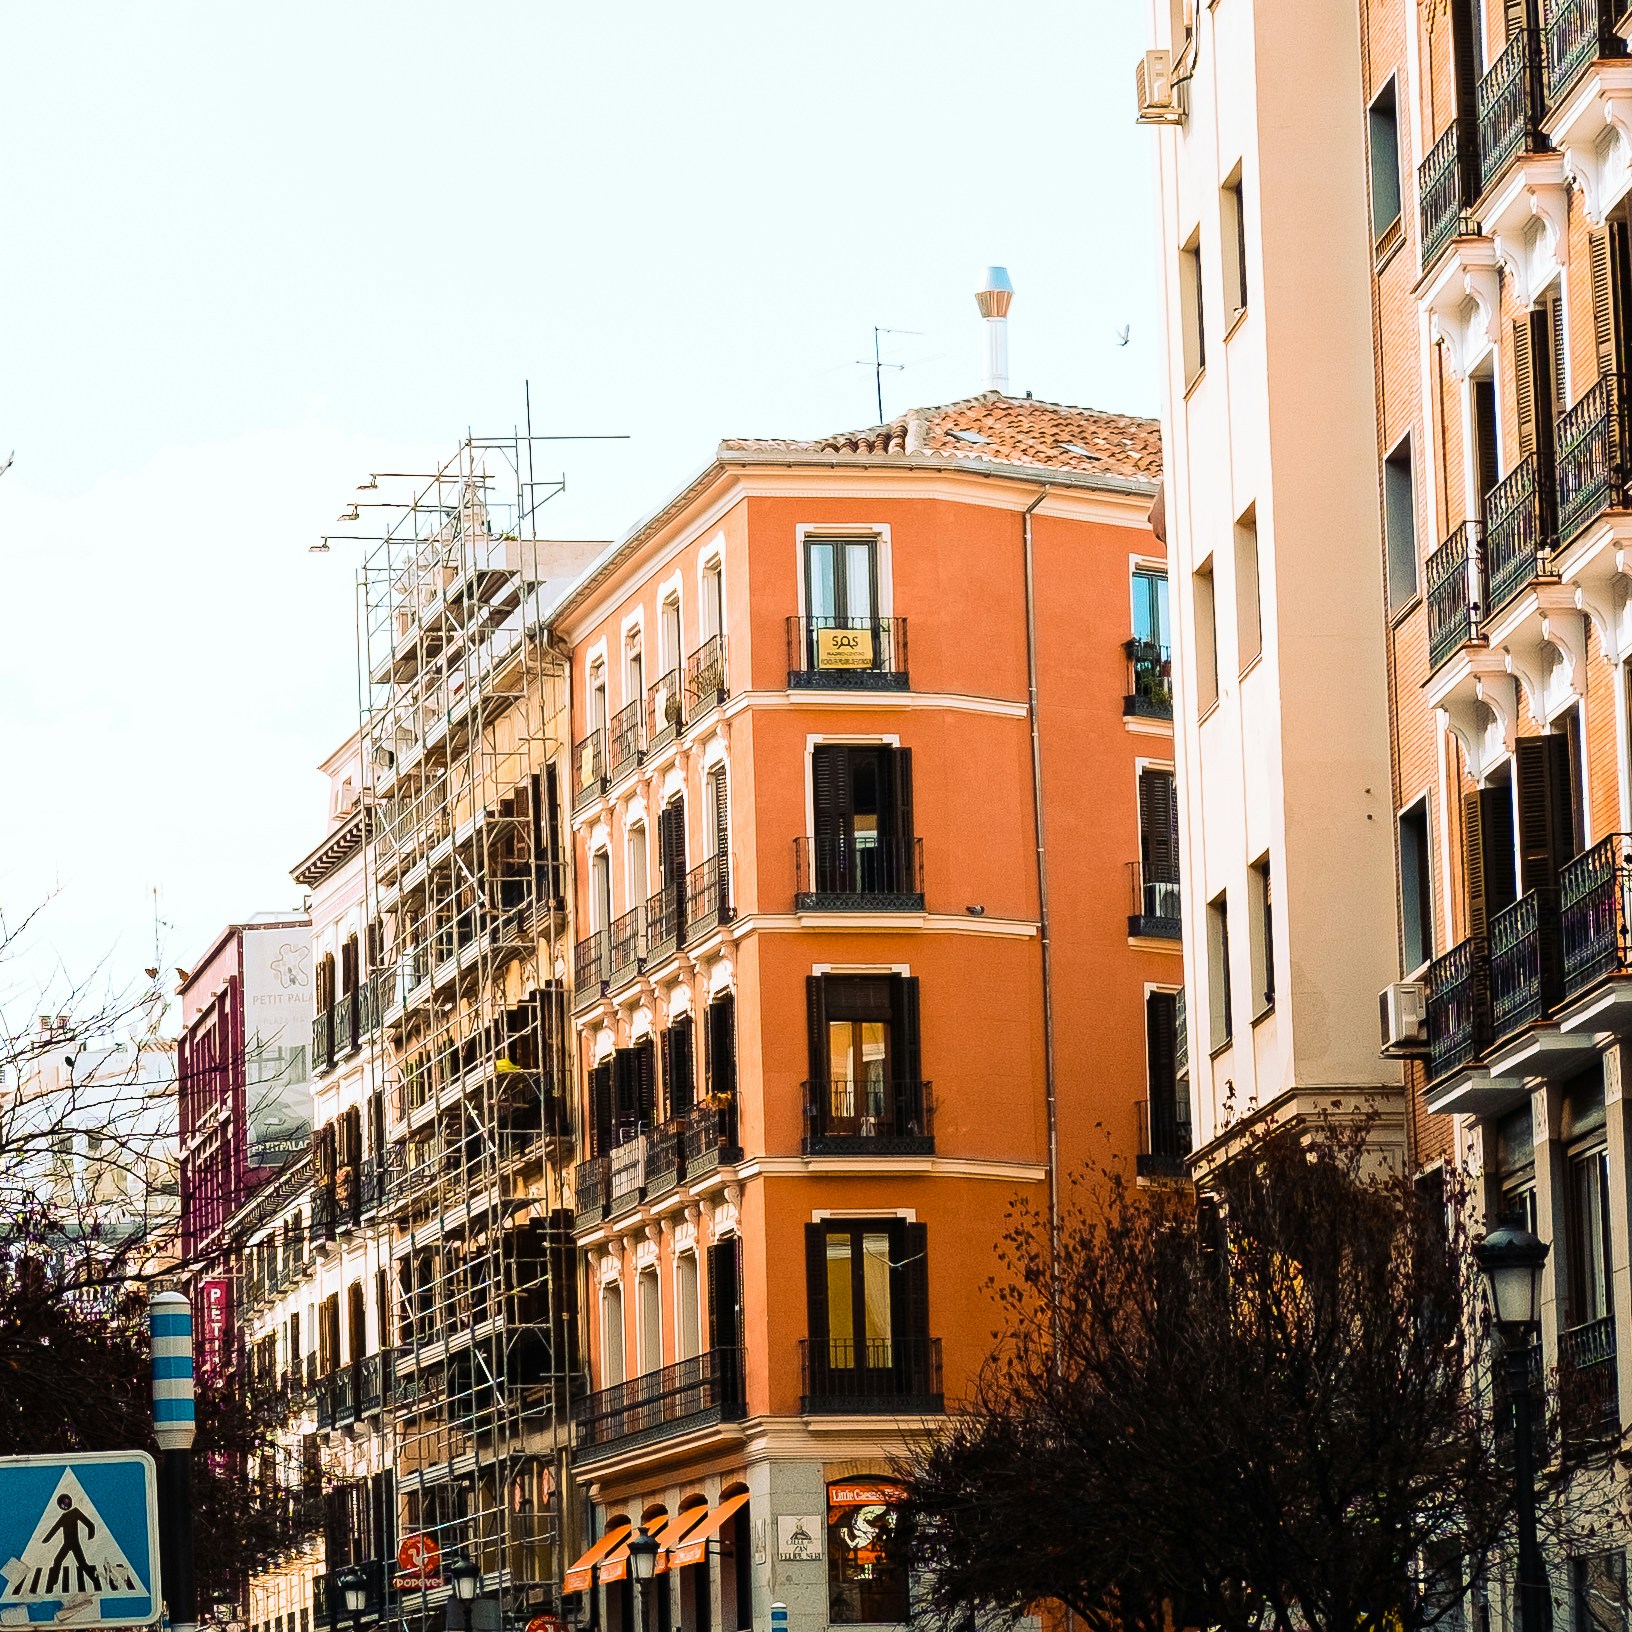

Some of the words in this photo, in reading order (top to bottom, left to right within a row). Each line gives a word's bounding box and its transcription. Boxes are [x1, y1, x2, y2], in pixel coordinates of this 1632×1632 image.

[252, 994, 284, 1006] PETIT
[287, 990, 314, 1003] PALA
[396, 1578, 445, 1588] POPEYES
